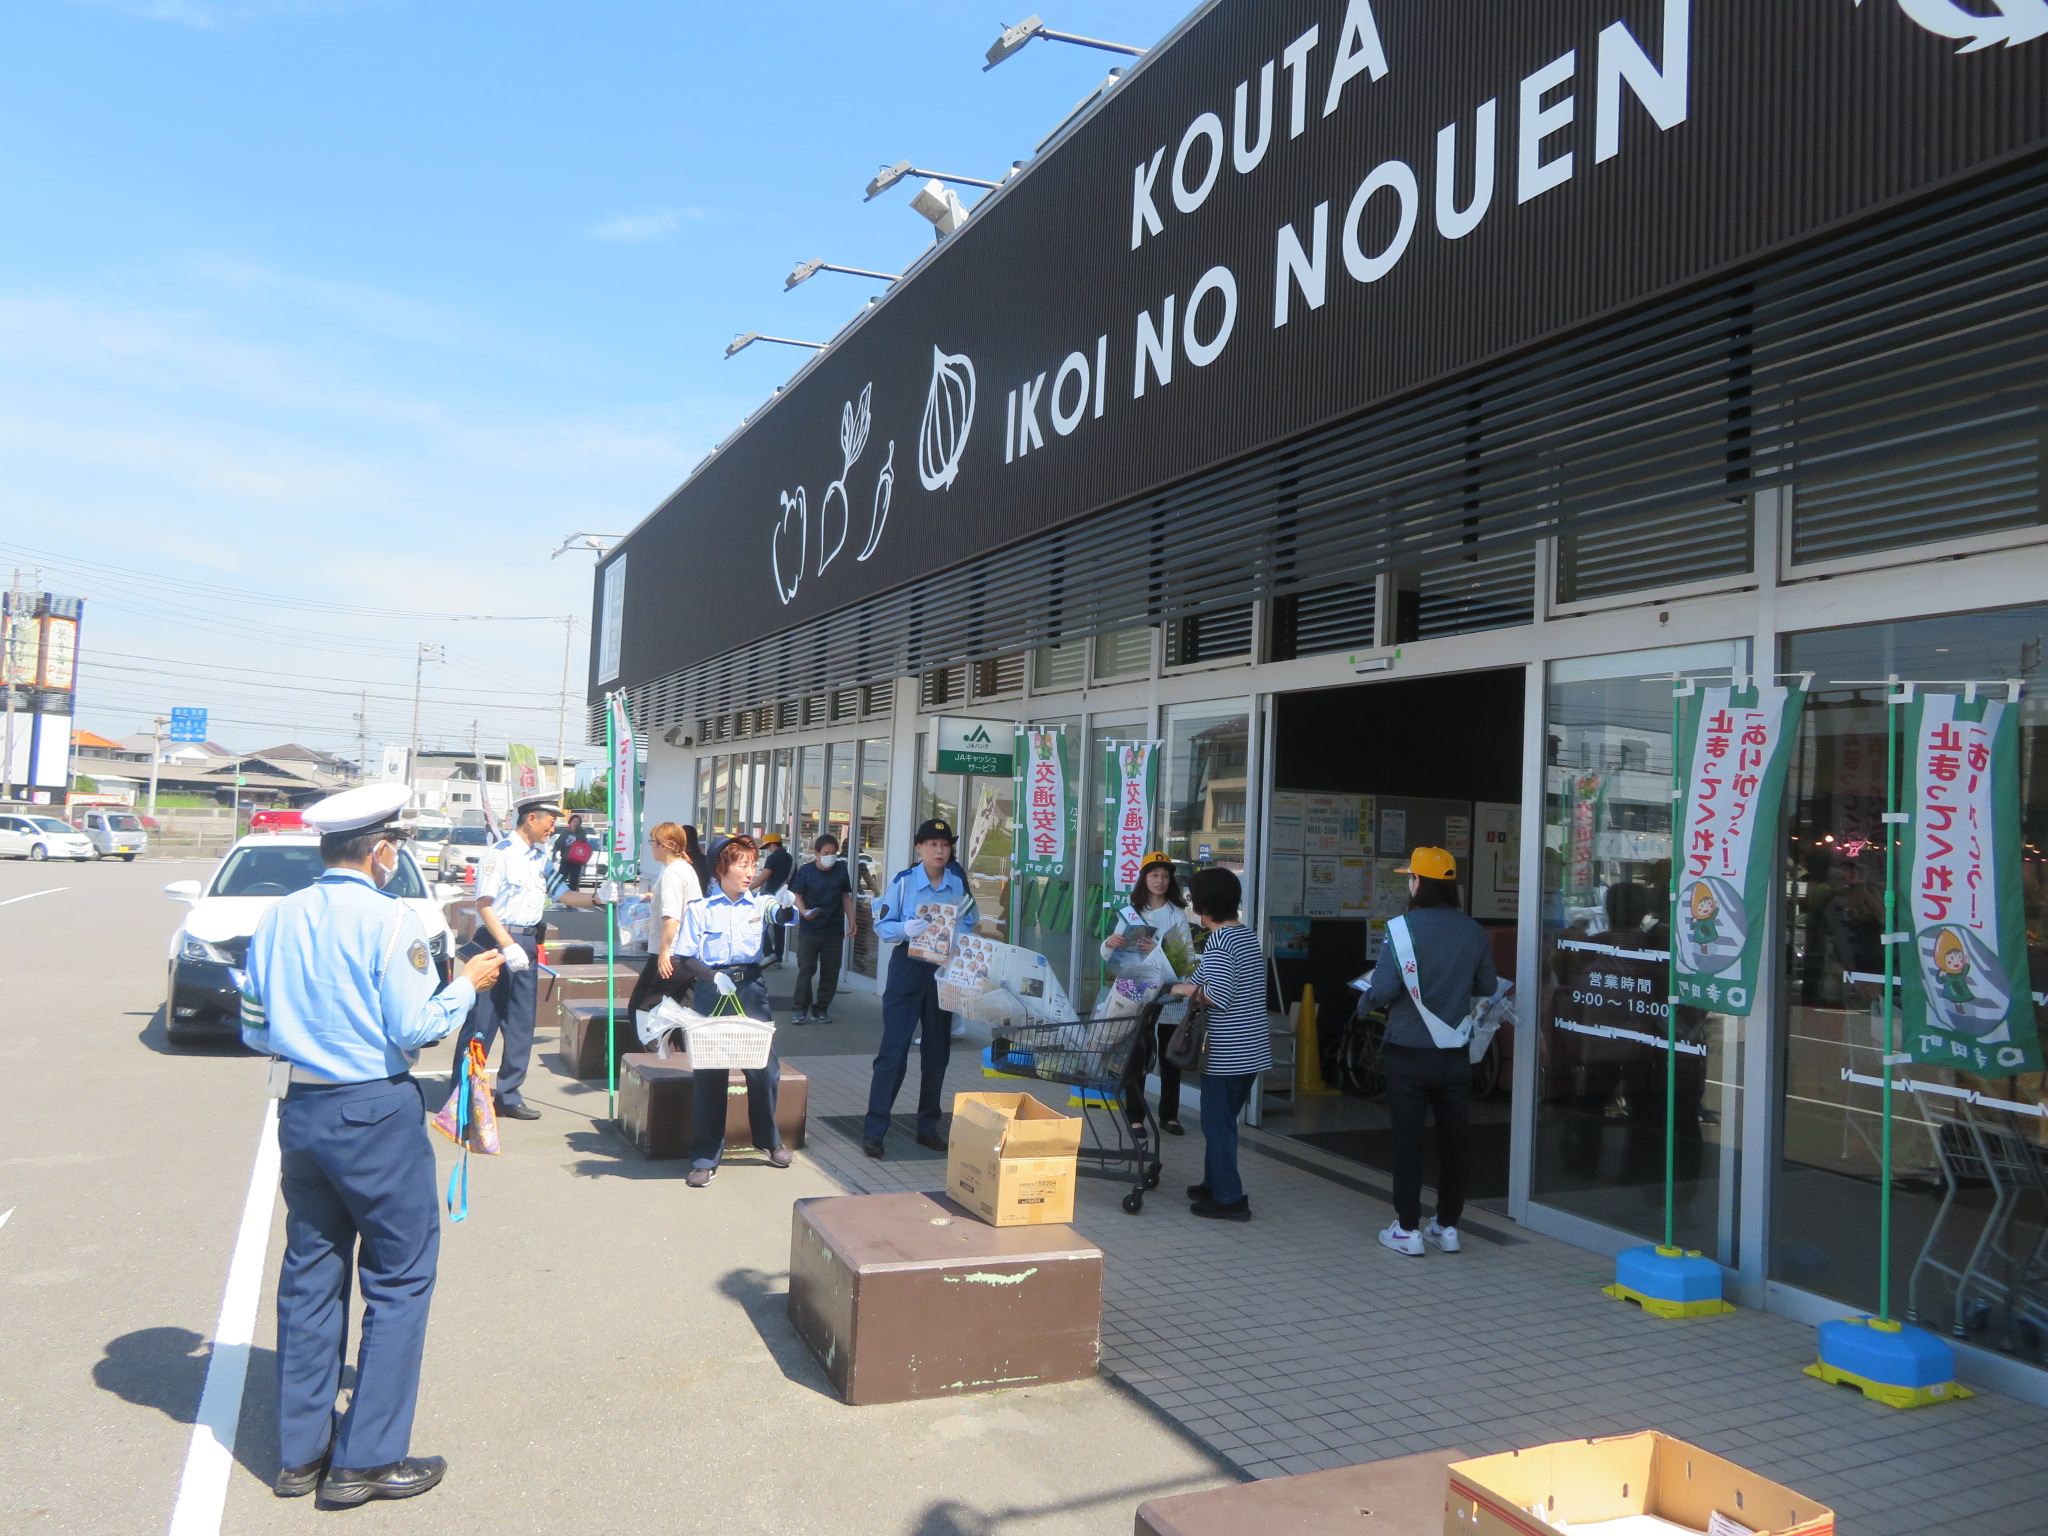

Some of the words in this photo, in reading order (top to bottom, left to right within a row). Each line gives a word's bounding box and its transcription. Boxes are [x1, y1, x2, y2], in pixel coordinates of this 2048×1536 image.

[1132, 0, 1388, 250] KOUTA
[1006, 334, 1106, 464] IKOI
[1134, 265, 1237, 399] NO
[1274, 0, 1689, 328] NOUEN
[955, 753, 997, 763] JAキャッシュ
[968, 763, 997, 772] サービス
[1589, 972, 1652, 994] 営業時間
[1573, 990, 1603, 1007] 9:00
[1627, 999, 1669, 1018] 18:00
